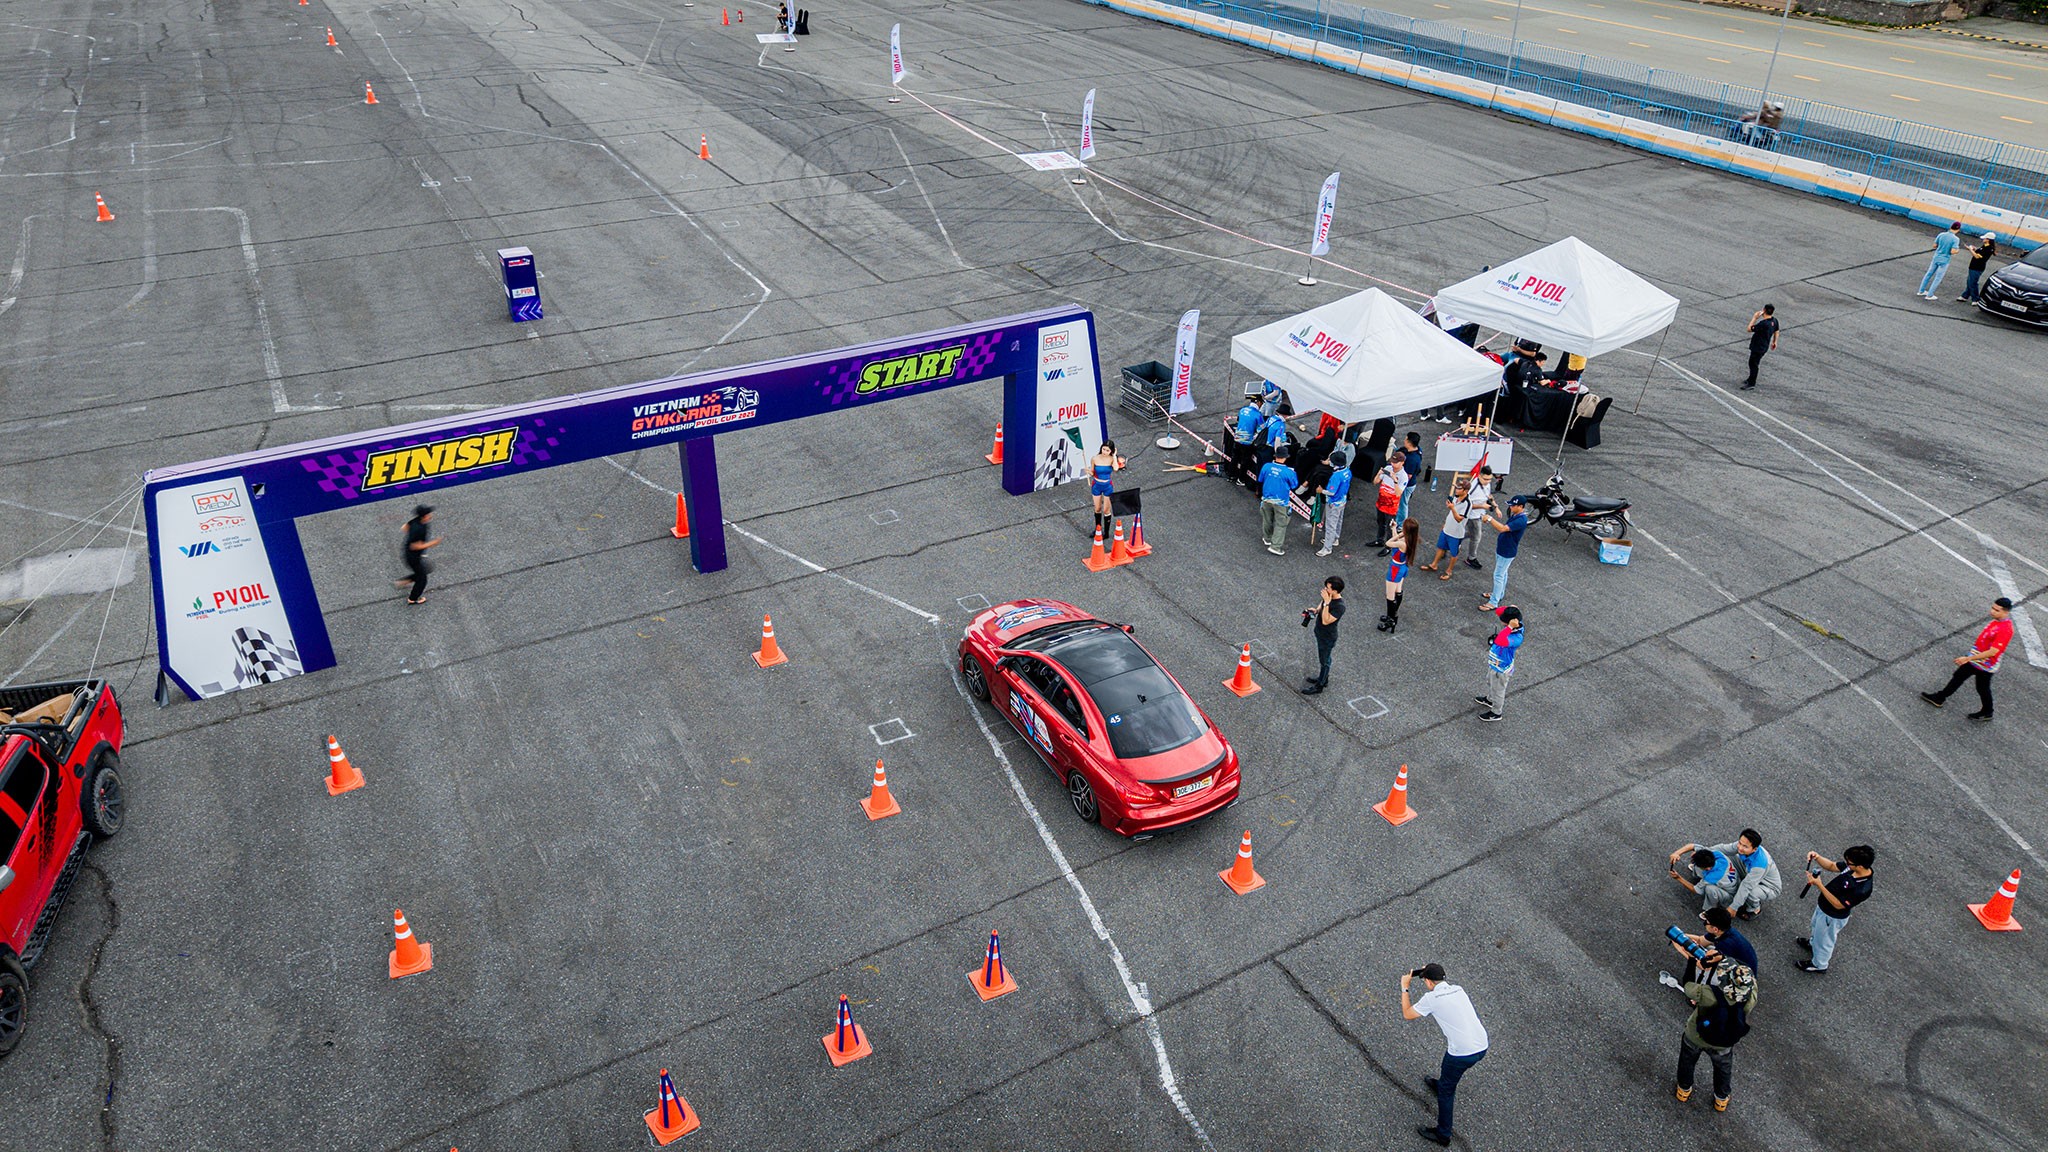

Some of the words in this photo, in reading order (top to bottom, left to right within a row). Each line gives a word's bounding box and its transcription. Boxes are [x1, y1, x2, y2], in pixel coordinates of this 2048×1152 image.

[1521, 276, 1566, 302] PVOIL
[1310, 331, 1352, 362] PVOIL
[857, 346, 964, 393] START
[633, 396, 700, 417] VIETNAM
[1058, 402, 1088, 421] PVOIL
[632, 422, 694, 440] CHAMPIONSHIP
[696, 418, 718, 427] PVOIL
[720, 414, 736, 422] CUP
[364, 429, 517, 488] FINISH
[197, 492, 233, 505] OTV
[198, 500, 238, 512] MEDIA
[213, 584, 270, 609] PVOIL
[1110, 715, 1121, 724] 45
